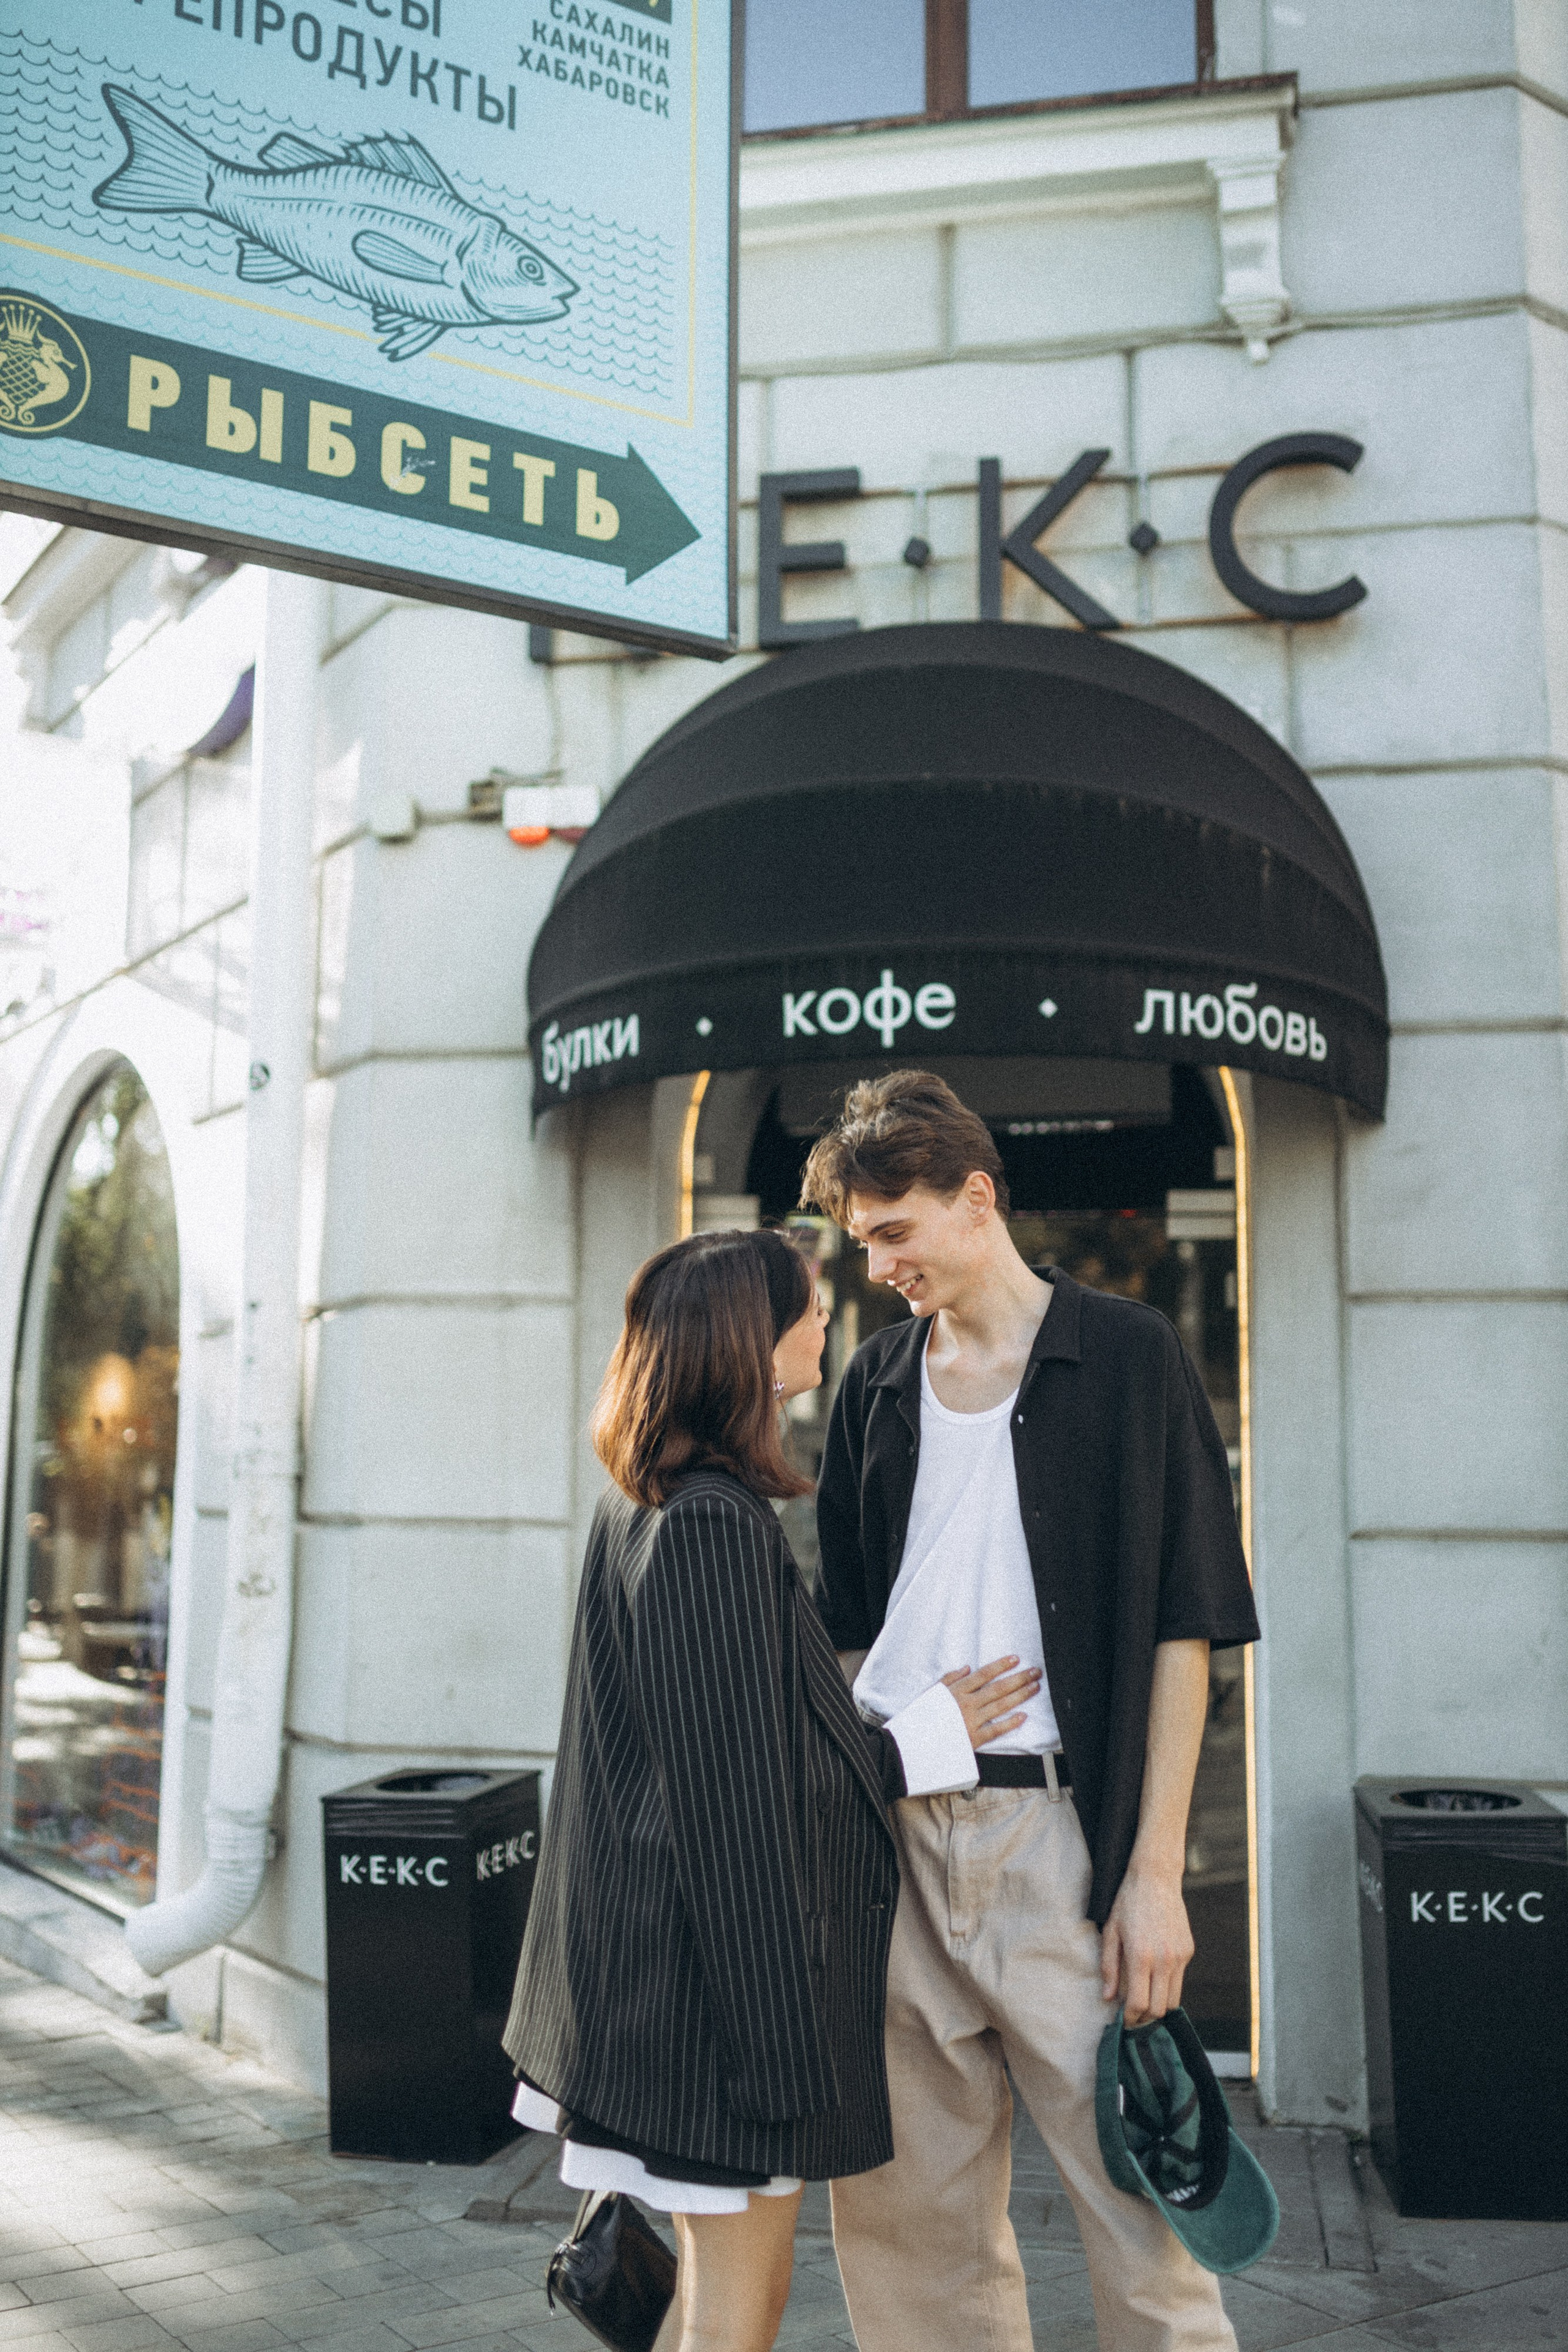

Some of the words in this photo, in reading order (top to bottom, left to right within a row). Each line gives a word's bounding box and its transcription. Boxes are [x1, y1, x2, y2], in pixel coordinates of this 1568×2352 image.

[134, 0, 516, 130] ПРОДУКТЫ
[532, 19, 669, 89] КАМЧАТКА
[551, 0, 669, 59] САХАЛИН
[518, 45, 669, 118] ХАБАРОВСК
[127, 354, 620, 541] РЫБСЕТЬ
[542, 1013, 640, 1093] булки
[782, 969, 957, 1048] кофе
[1134, 982, 1327, 1061] любовь
